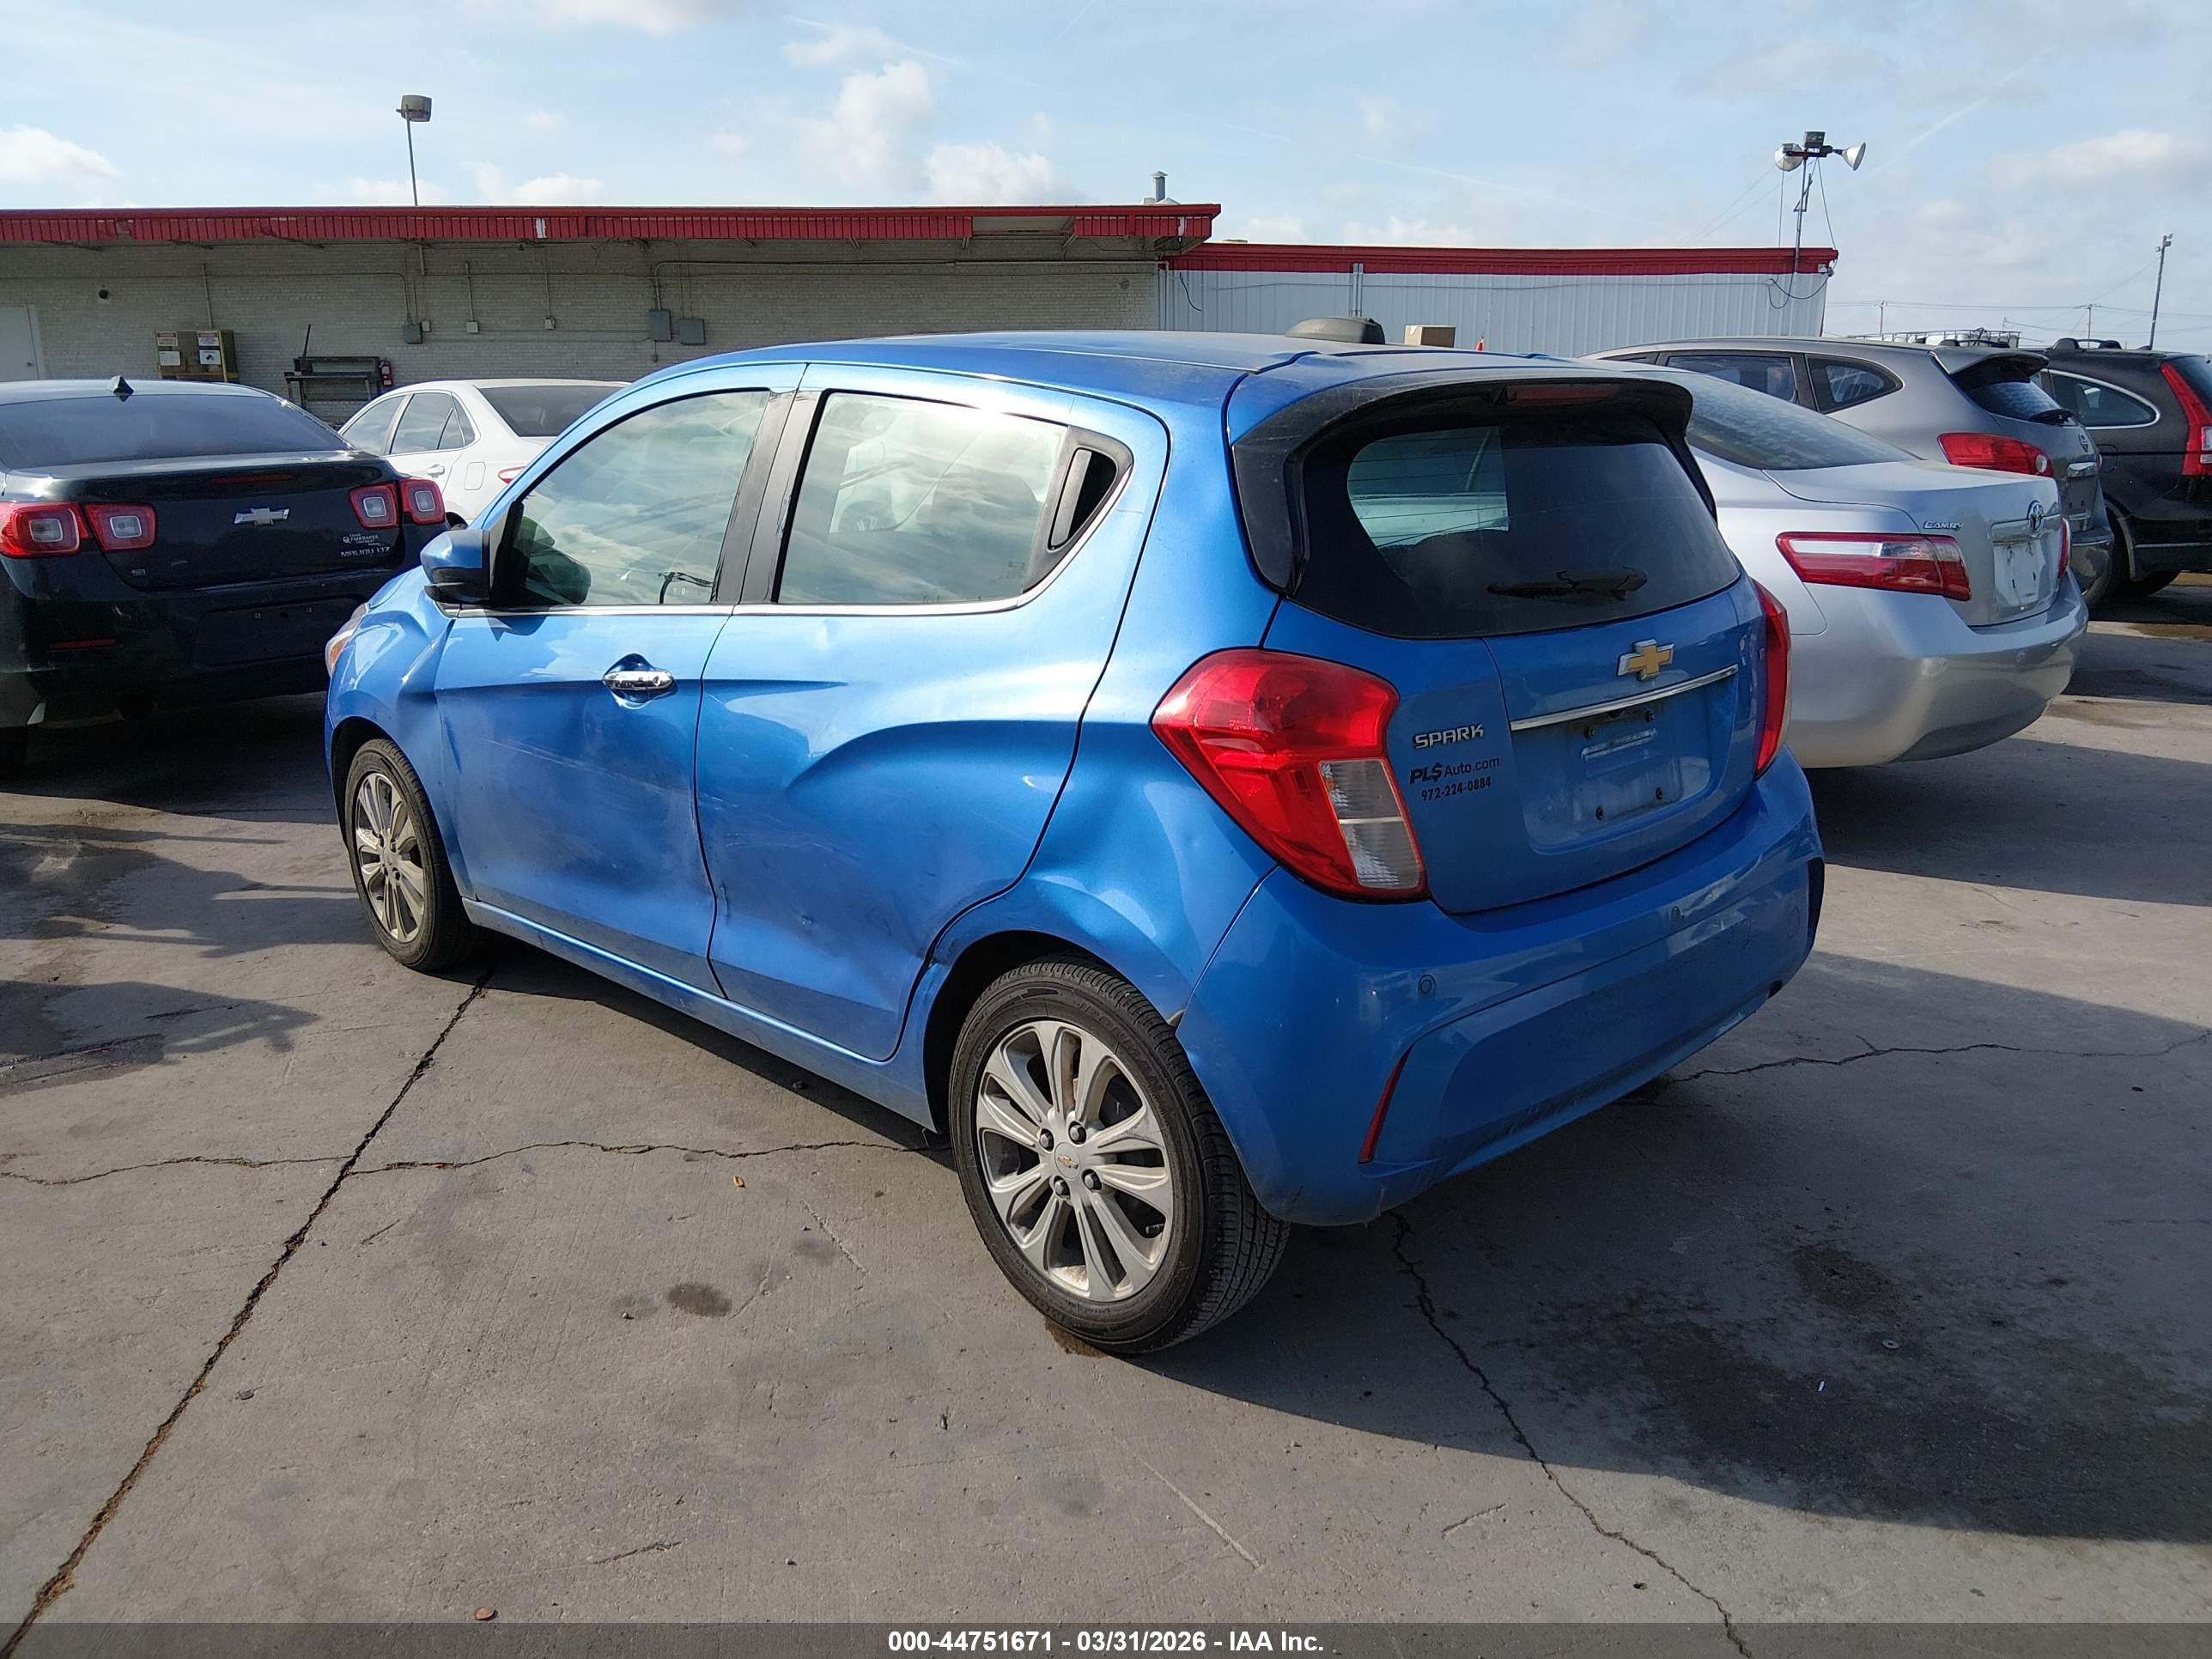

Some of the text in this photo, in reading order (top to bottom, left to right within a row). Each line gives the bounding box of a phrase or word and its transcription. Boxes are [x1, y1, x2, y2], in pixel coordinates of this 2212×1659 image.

[1923, 520, 1964, 531] CAMRY
[1414, 723, 1484, 749] SPARK
[1421, 775, 1492, 801] 972-224-0884
